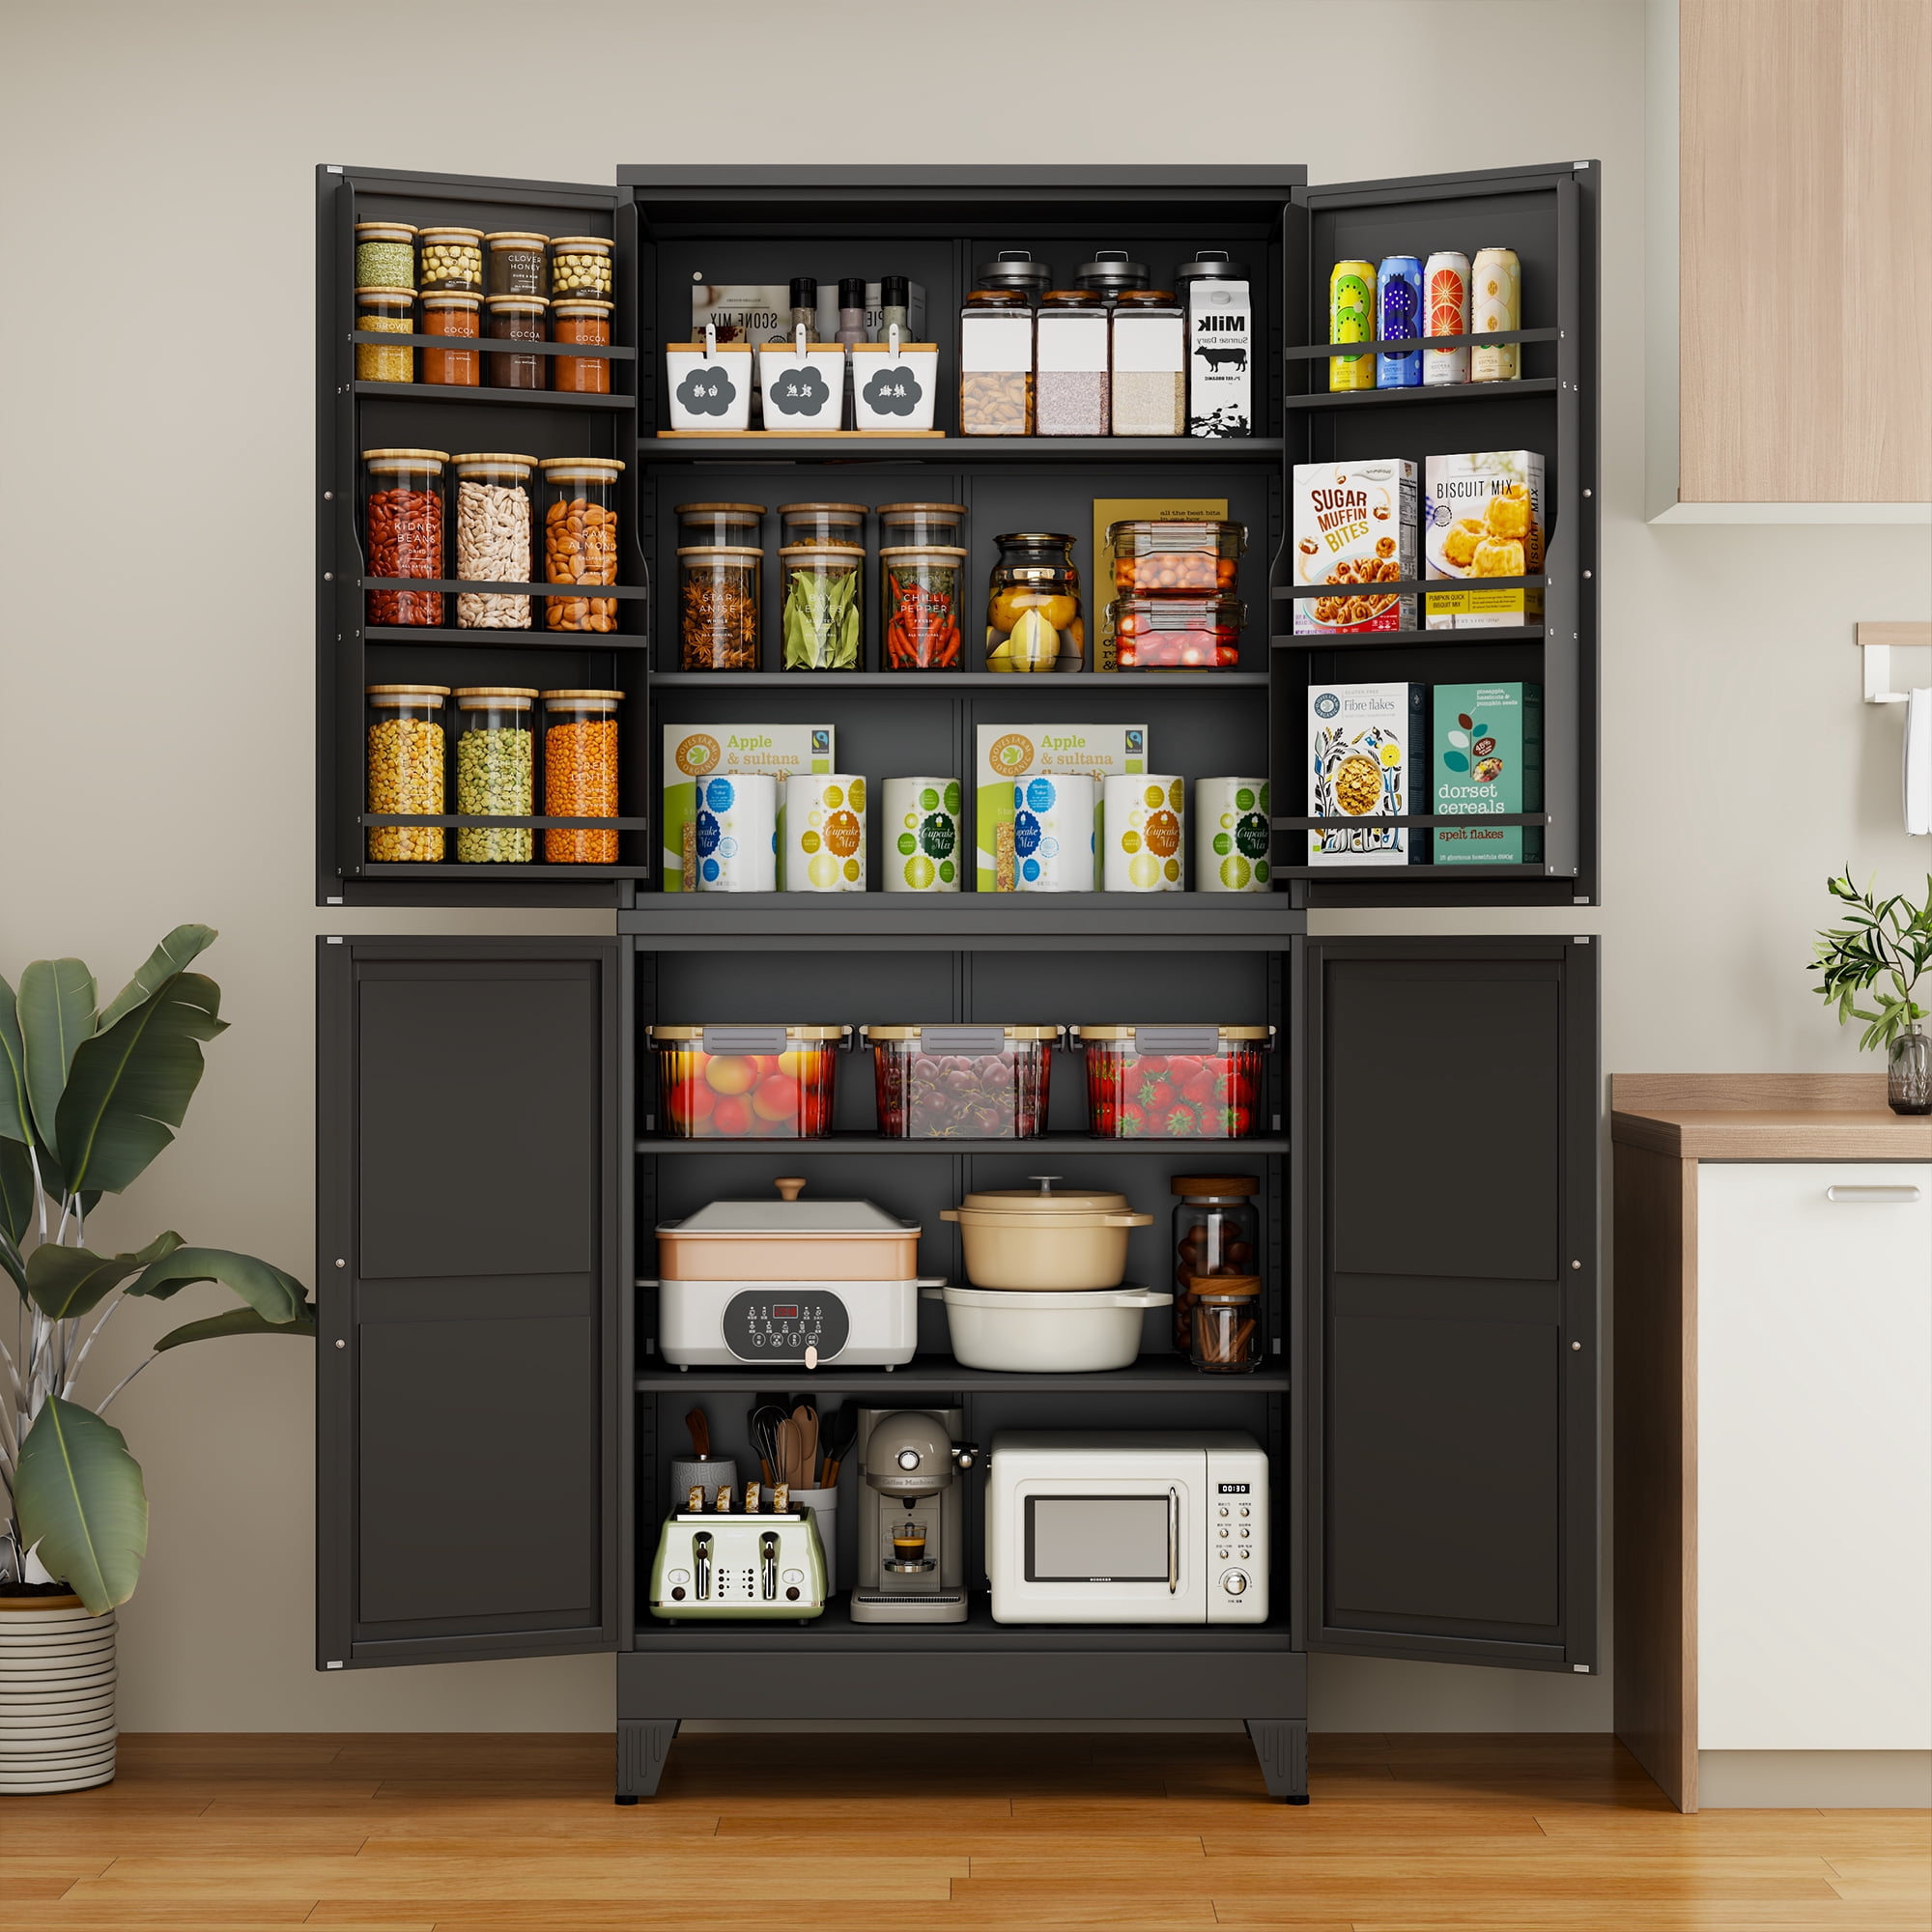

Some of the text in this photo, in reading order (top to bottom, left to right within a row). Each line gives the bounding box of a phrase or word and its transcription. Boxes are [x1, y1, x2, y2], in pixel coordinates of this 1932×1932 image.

[376, 323, 409, 331] BROWN
[1436, 479, 1513, 499] BISCUIT MIX
[1311, 489, 1368, 513] SUGAR
[1317, 508, 1367, 532] MUFFIN
[394, 522, 438, 532] KIDNEY
[397, 533, 436, 543] BEANS
[582, 529, 608, 539] RAW
[1324, 521, 1369, 553] BITES
[568, 541, 617, 552] ALMOND
[903, 593, 944, 602] CHILLI
[698, 604, 735, 612] ANISE
[795, 604, 842, 613] LEAVES
[900, 604, 948, 612] PEPPER
[1344, 698, 1395, 711] Fibre flakes
[726, 734, 772, 751] Apple
[1040, 734, 1086, 751] Apple
[726, 752, 800, 765] & sultana
[1040, 752, 1114, 765] & sultana
[583, 761, 607, 771] RED
[571, 773, 616, 782] LENTILS
[1438, 783, 1498, 799] dorset
[1438, 800, 1505, 814] cereals
[825, 825, 859, 838] Cupcake
[921, 827, 953, 840] Cupcake
[1146, 825, 1179, 838] Cupcake
[1438, 829, 1504, 841] spelt flakes
[838, 836, 856, 848] Mix
[933, 838, 952, 850] Mix
[1160, 836, 1176, 848] Mix
[1249, 838, 1266, 850] Mix
